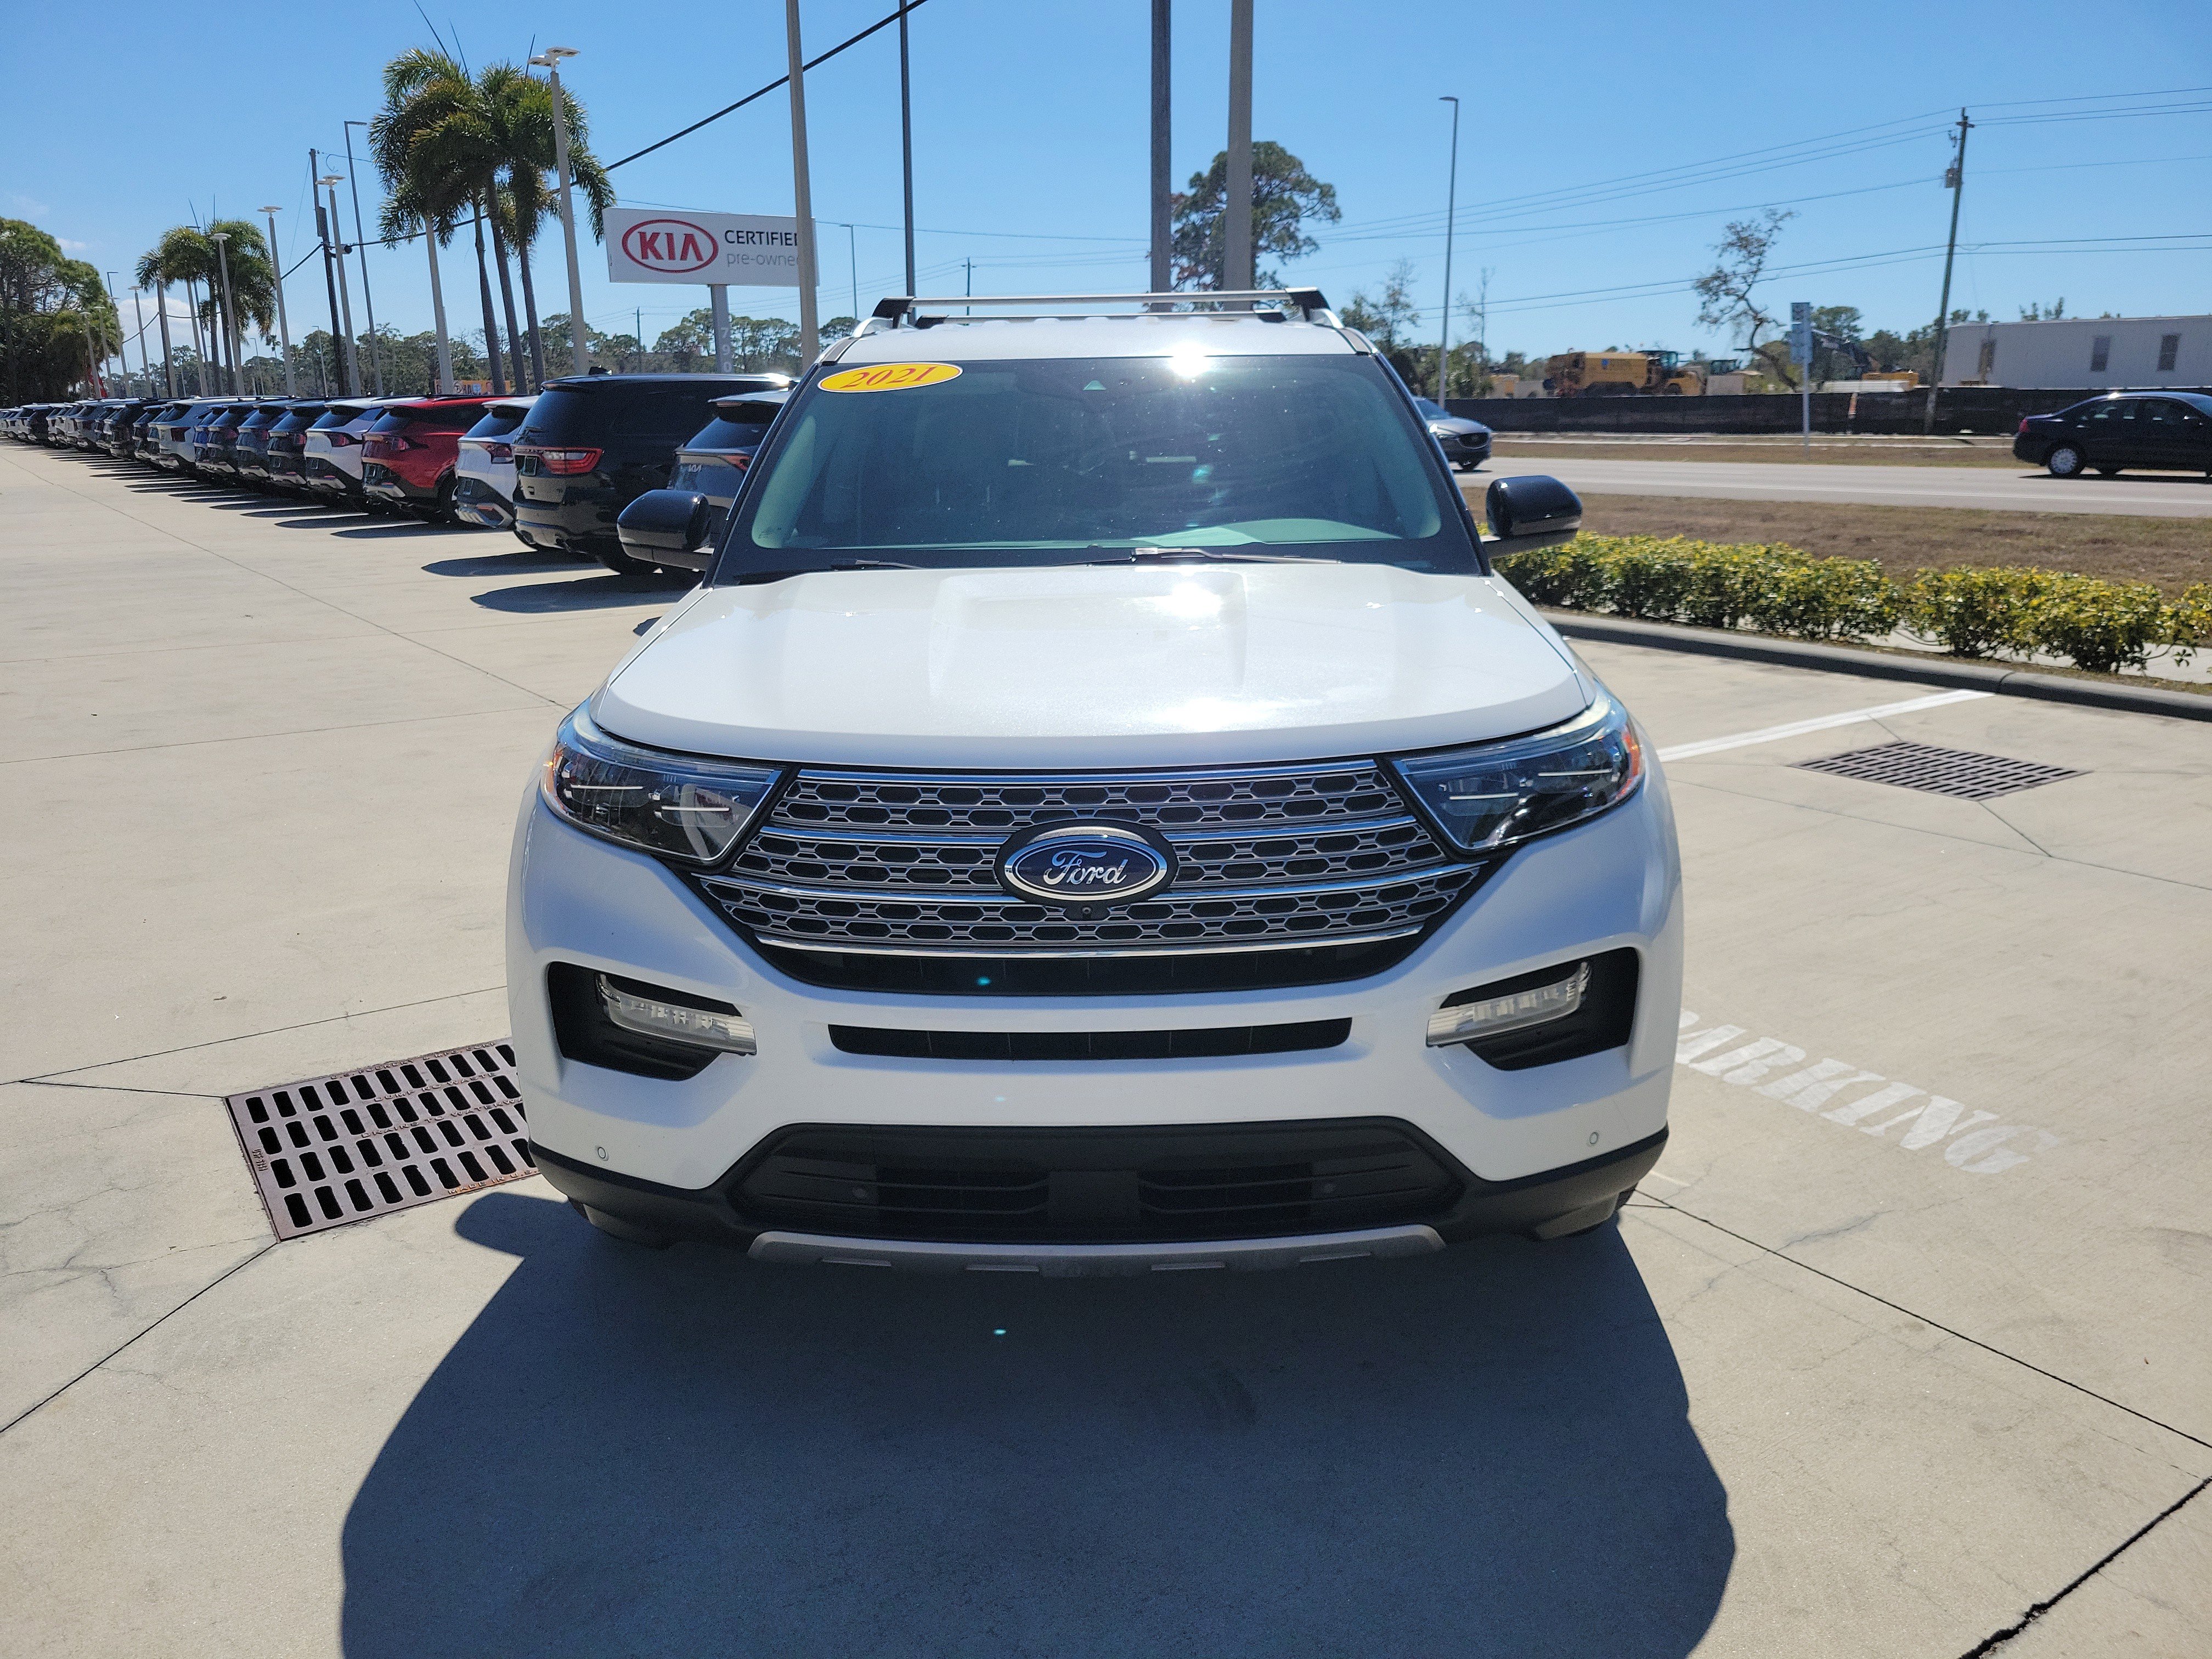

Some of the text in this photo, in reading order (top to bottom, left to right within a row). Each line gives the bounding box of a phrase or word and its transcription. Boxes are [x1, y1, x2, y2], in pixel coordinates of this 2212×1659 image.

[638, 232, 704, 262] KIA
[725, 230, 797, 246] CERTIFIE
[727, 254, 797, 267] pre-owne
[839, 366, 938, 389] 2021
[1043, 850, 1128, 885] Ford
[448, 1181, 487, 1195] MADE
